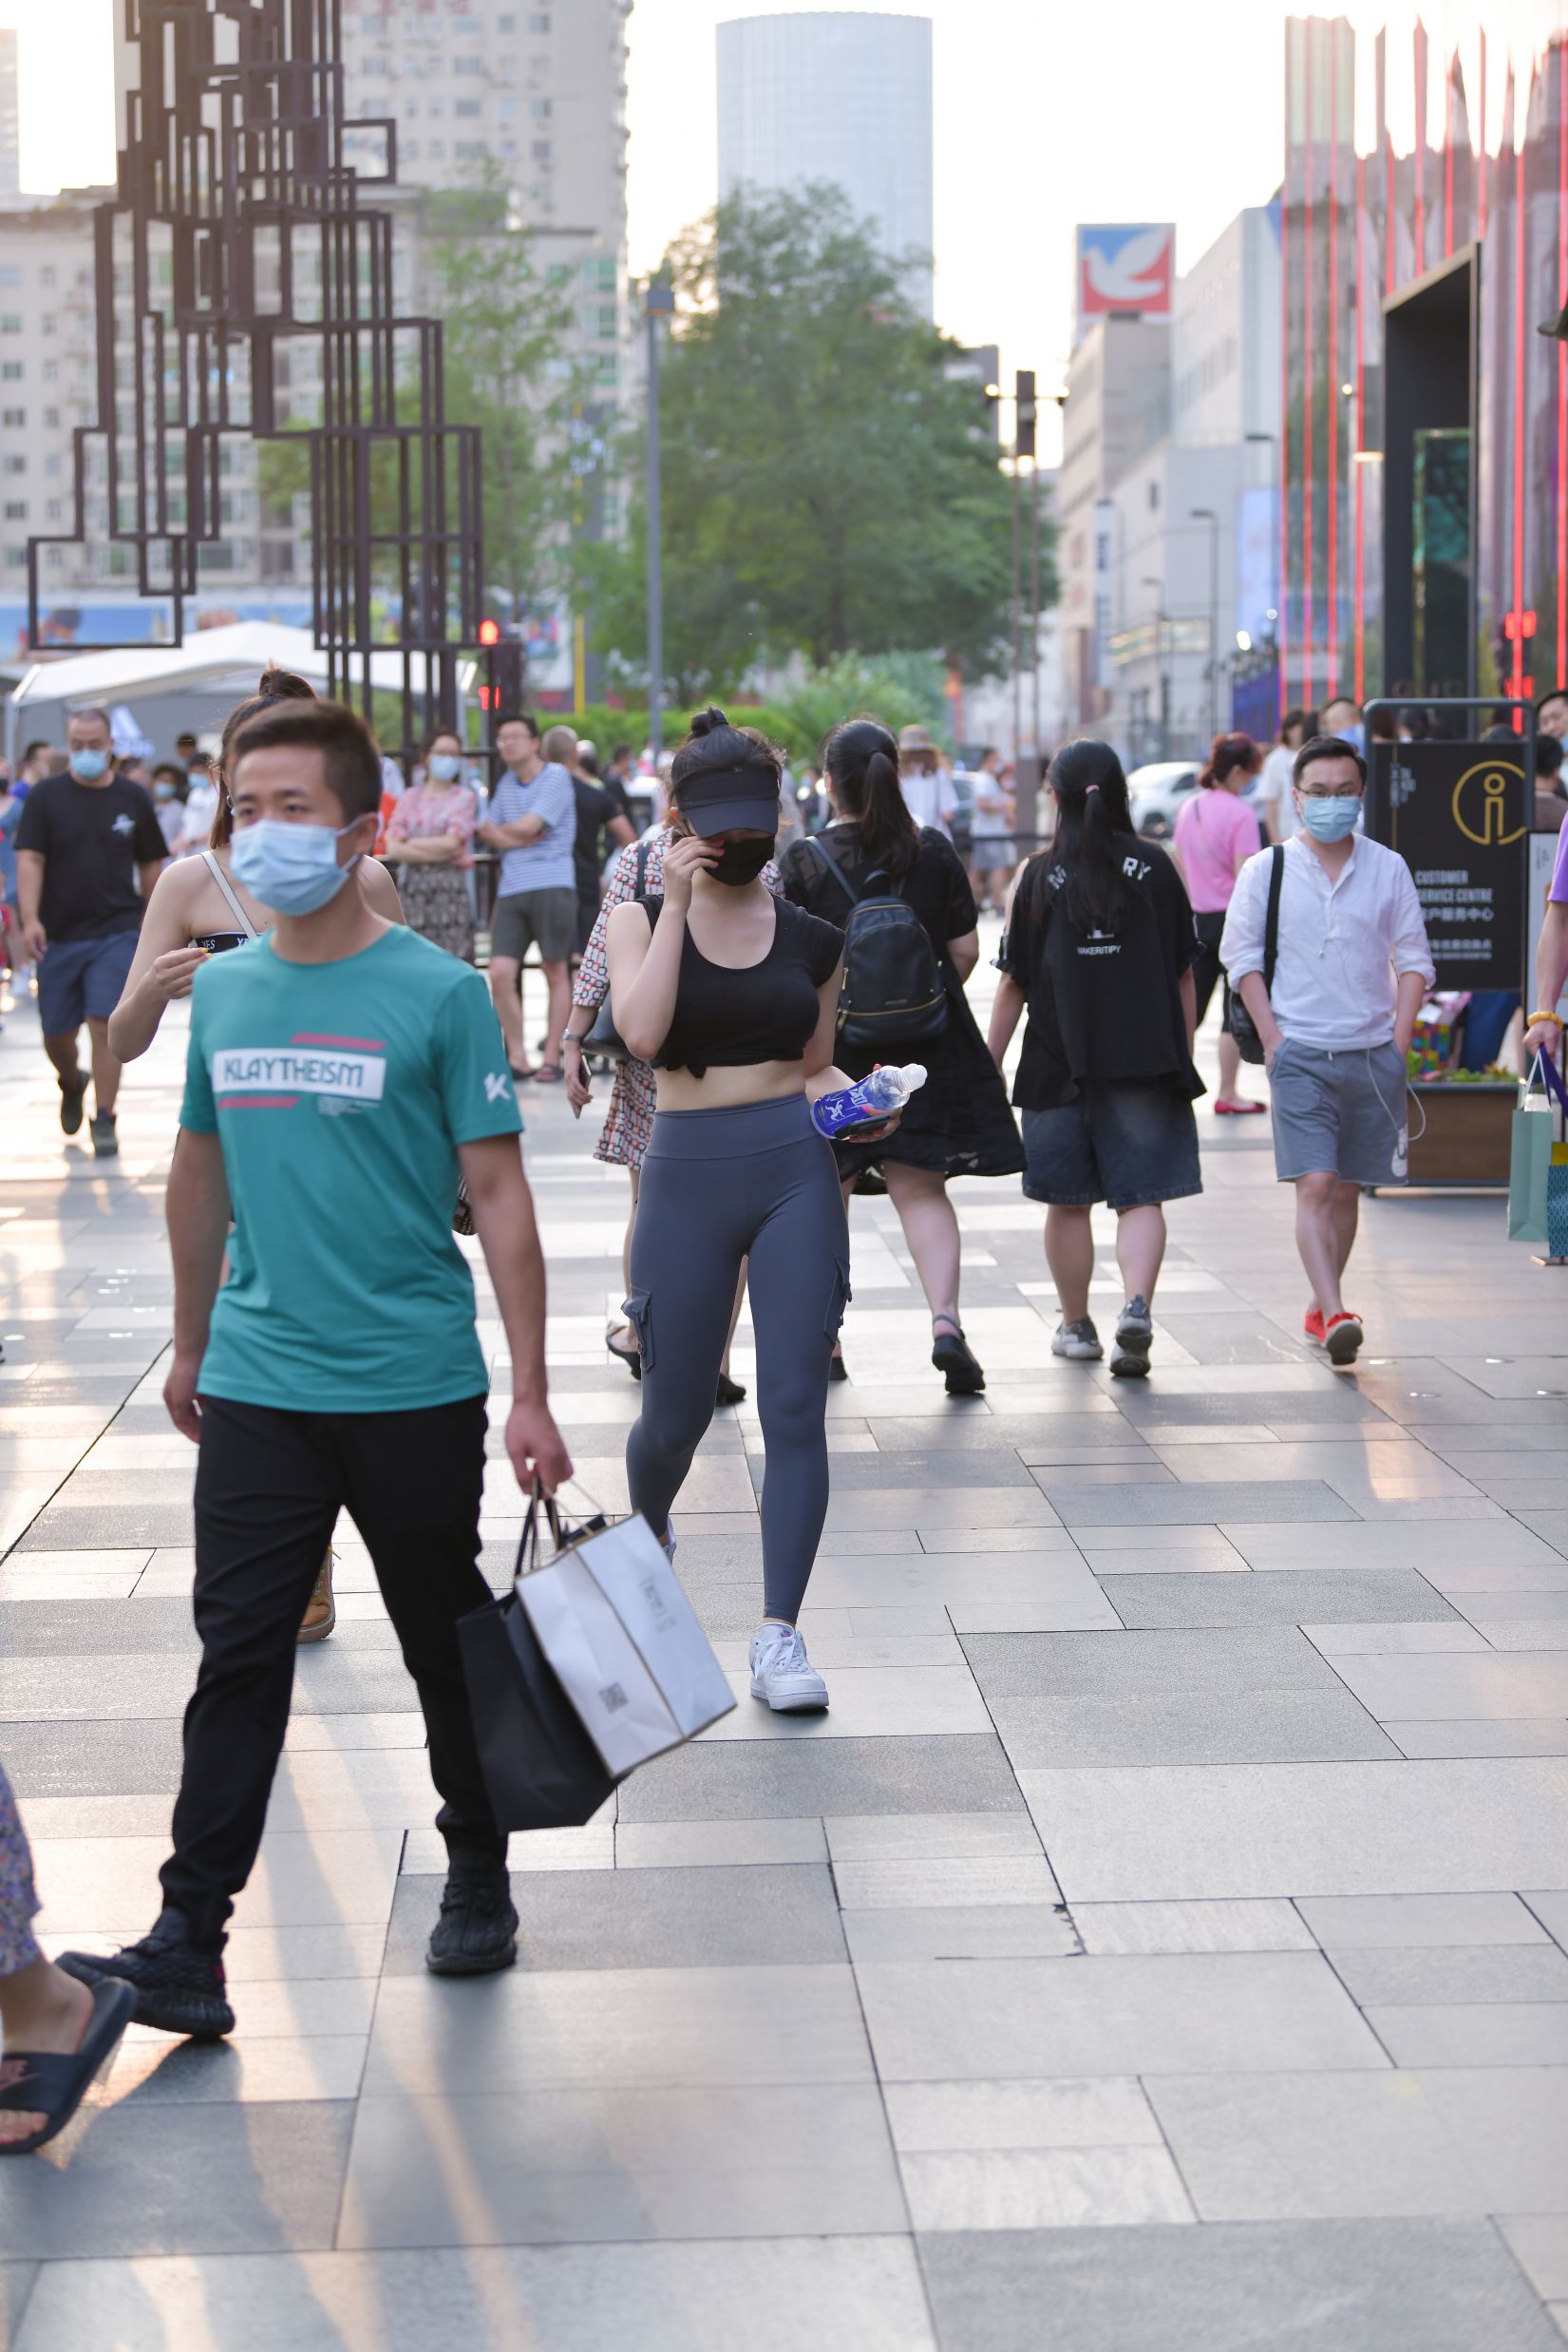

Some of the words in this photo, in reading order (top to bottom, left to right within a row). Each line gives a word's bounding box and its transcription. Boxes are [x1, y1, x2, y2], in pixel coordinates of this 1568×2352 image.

[1415, 869, 1468, 885] CUSTOMER
[1456, 888, 1493, 903] CENTRE
[224, 1056, 364, 1088] KLAYTHEISM
